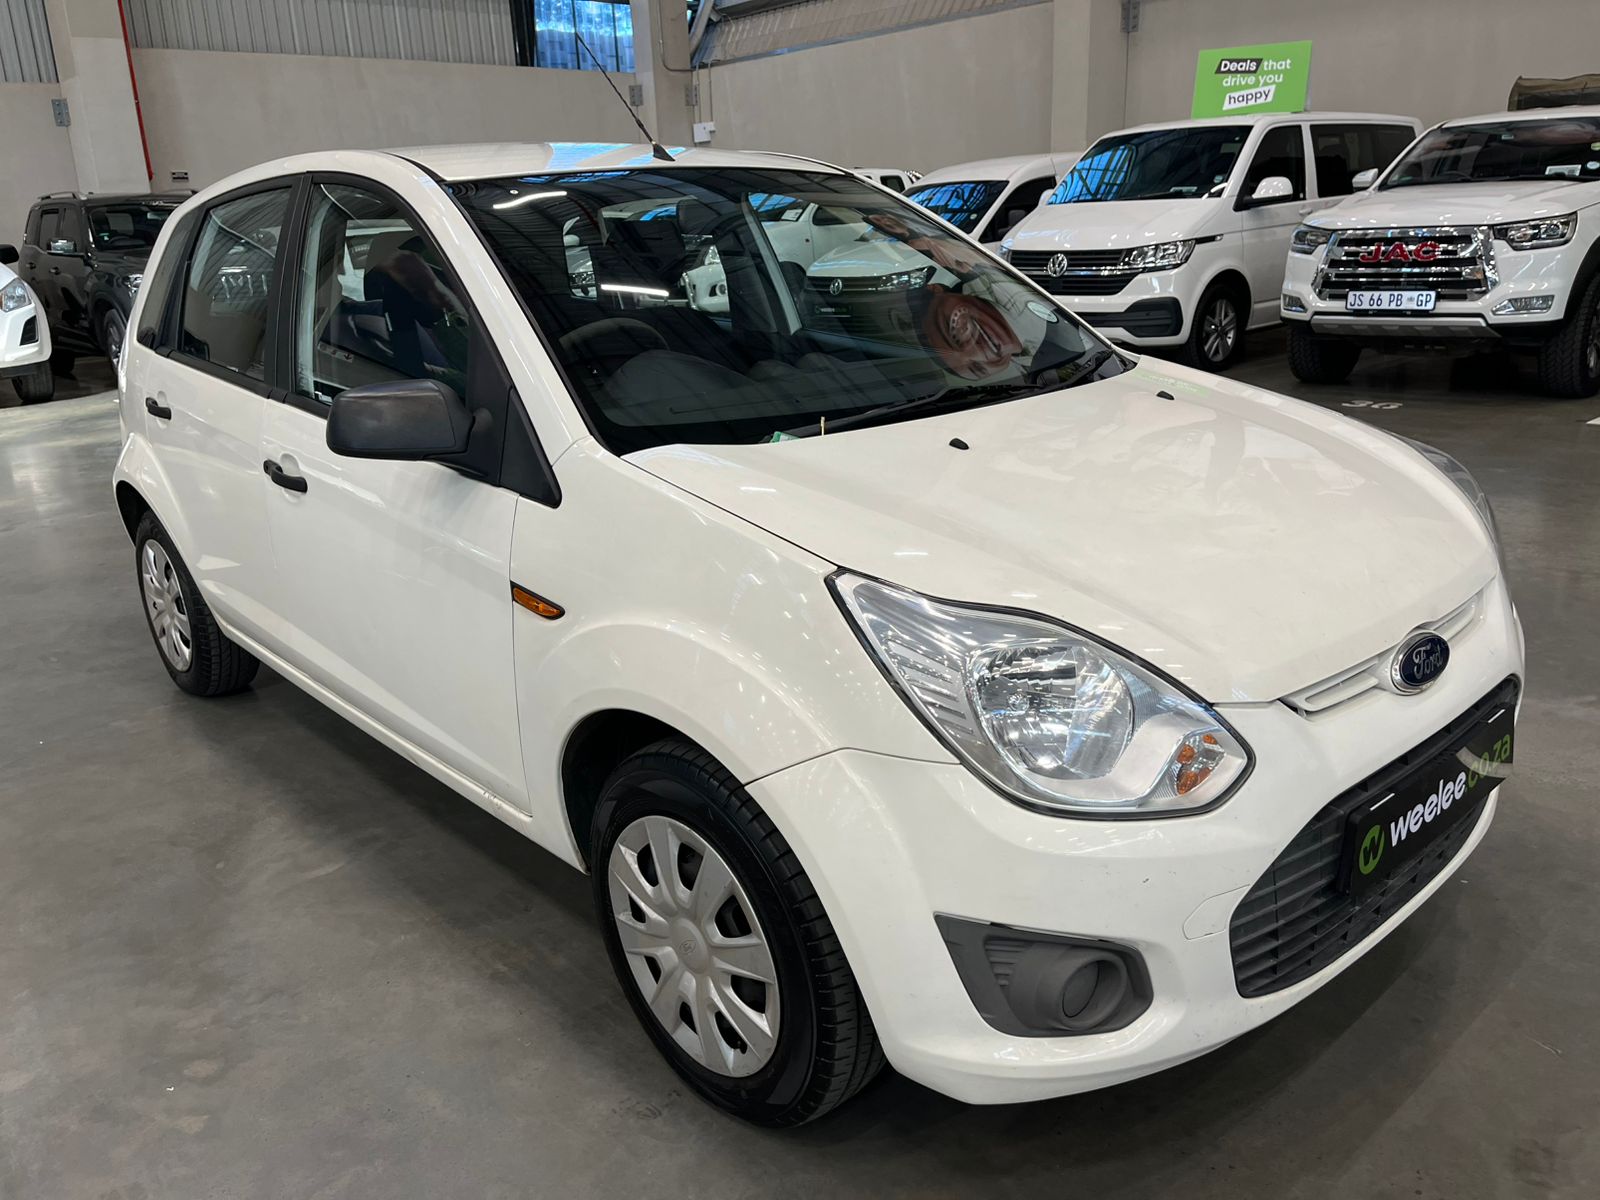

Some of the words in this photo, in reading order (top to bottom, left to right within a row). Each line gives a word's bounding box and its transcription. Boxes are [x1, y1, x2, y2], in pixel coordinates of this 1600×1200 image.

[1220, 60, 1257, 72] Deals
[1264, 58, 1291, 71] that
[1222, 74, 1255, 87] drive
[1258, 73, 1283, 87] you
[1228, 88, 1271, 105] happy
[1359, 241, 1441, 263] JAC
[1349, 293, 1364, 307] JS
[1368, 293, 1383, 307] 66
[1388, 293, 1403, 307] PB
[1416, 293, 1432, 307] GP
[1412, 642, 1443, 680] Ford
